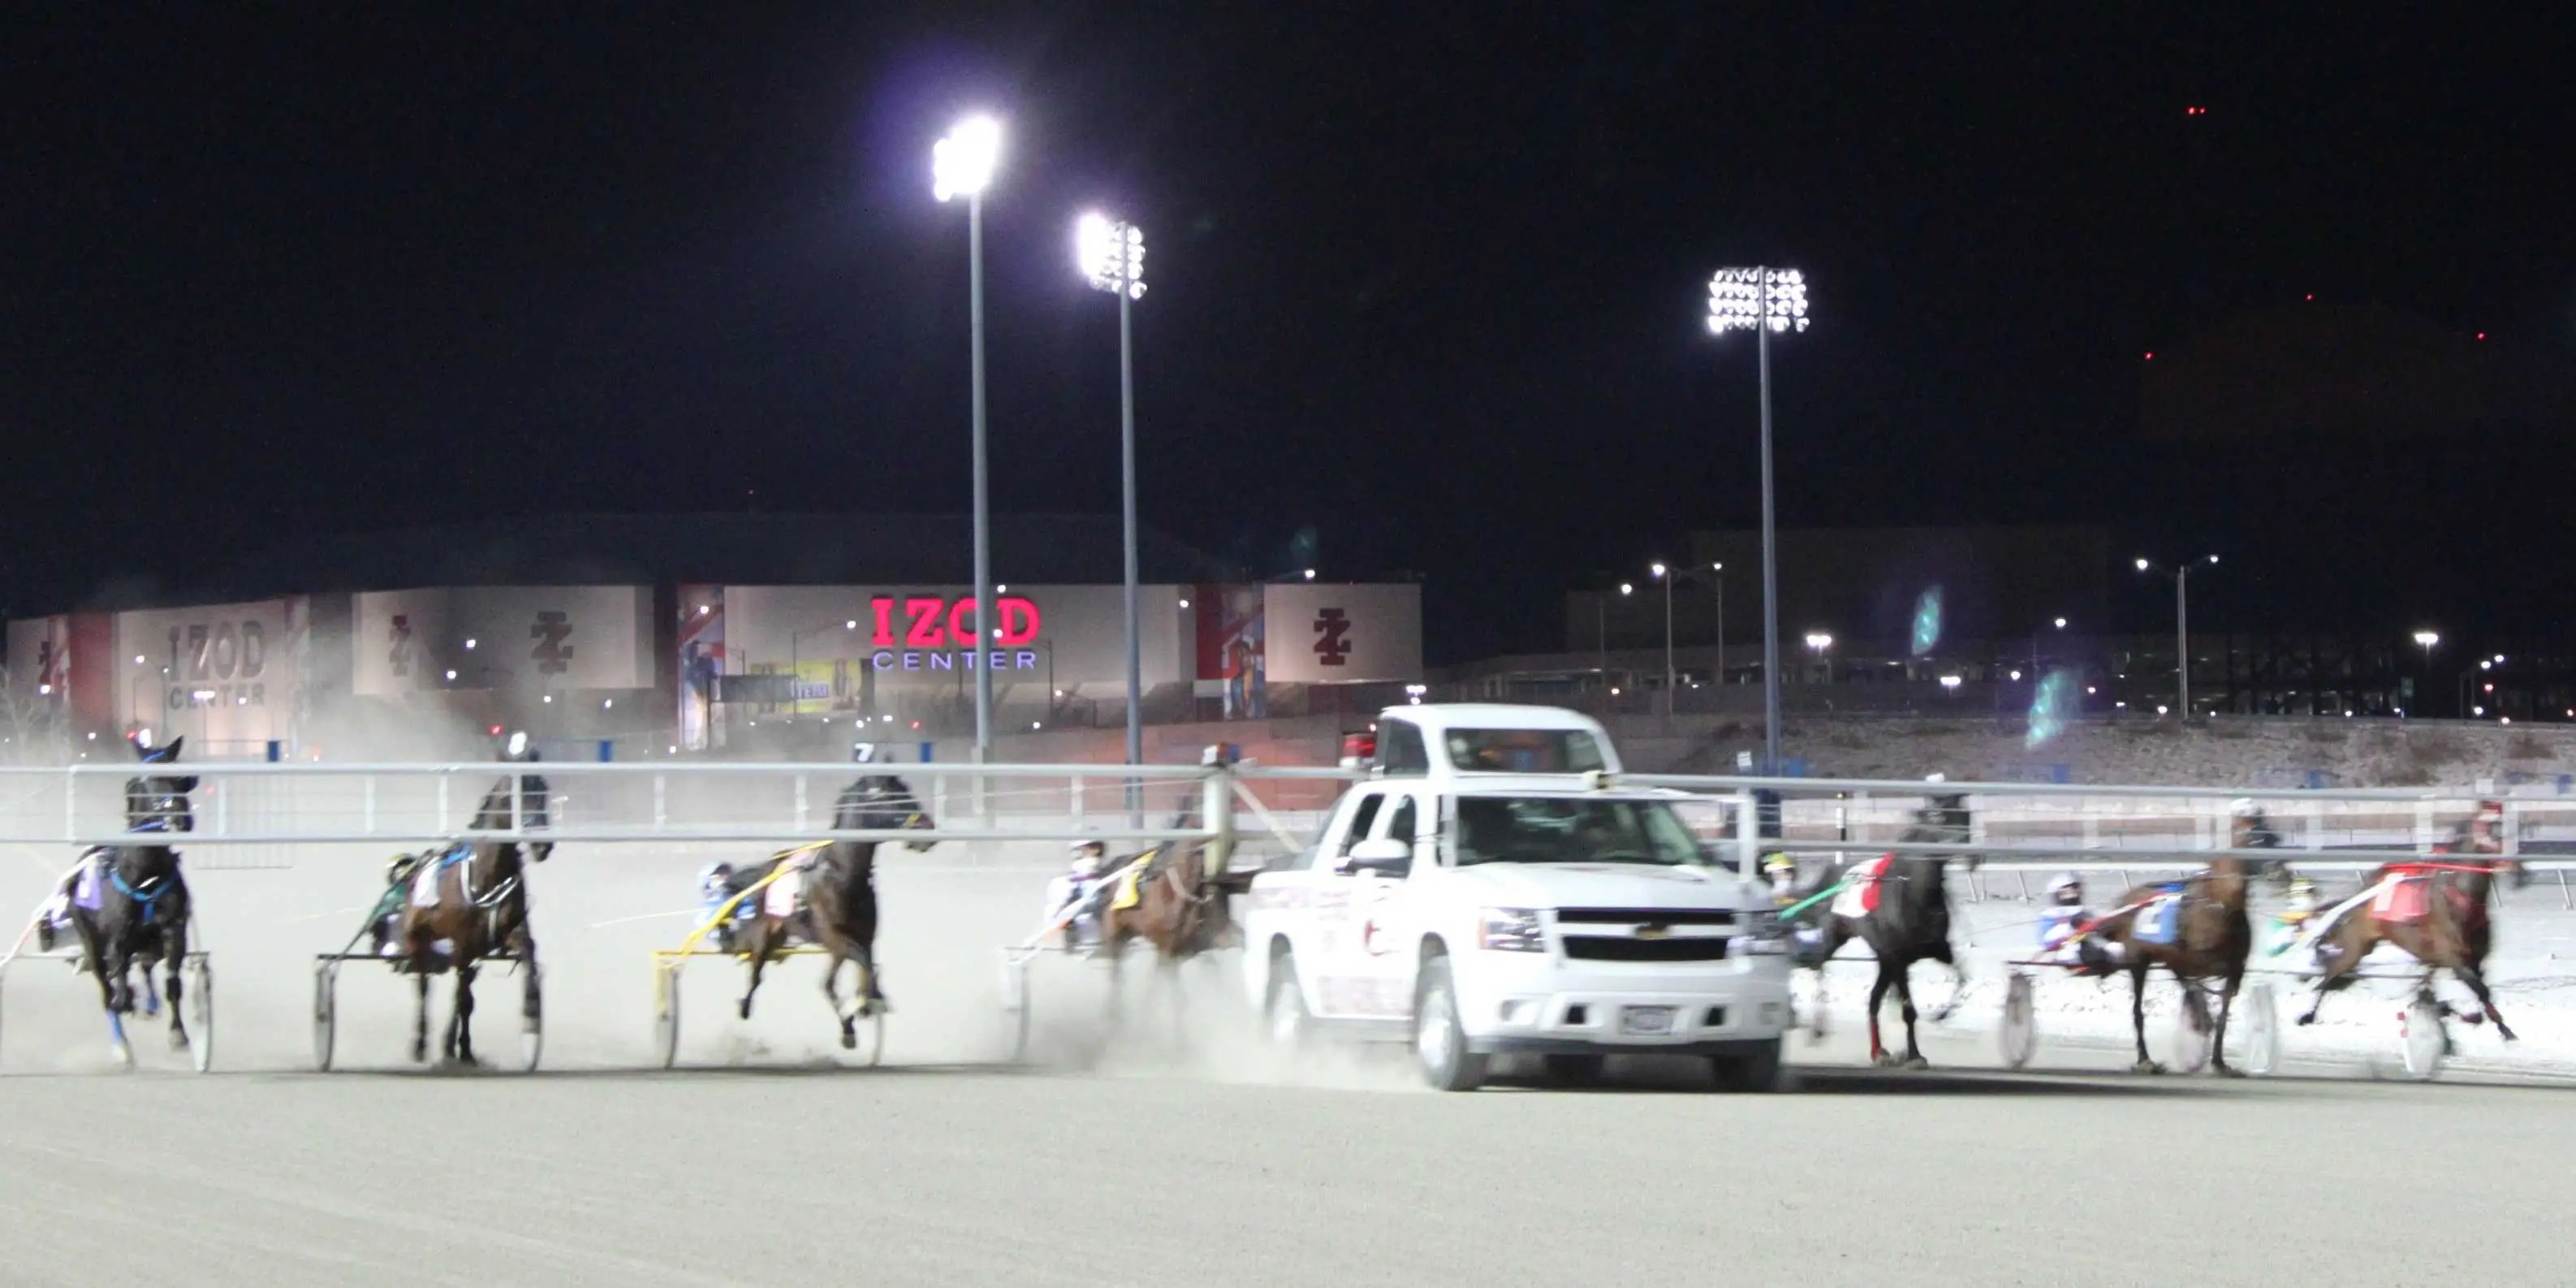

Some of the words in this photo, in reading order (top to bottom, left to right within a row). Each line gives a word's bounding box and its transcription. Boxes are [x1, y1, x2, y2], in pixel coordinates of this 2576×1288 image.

[870, 596, 1041, 647] IZOD
[168, 620, 266, 681] IZOD
[872, 651, 1037, 671] CENTER
[855, 742, 874, 762] 7
